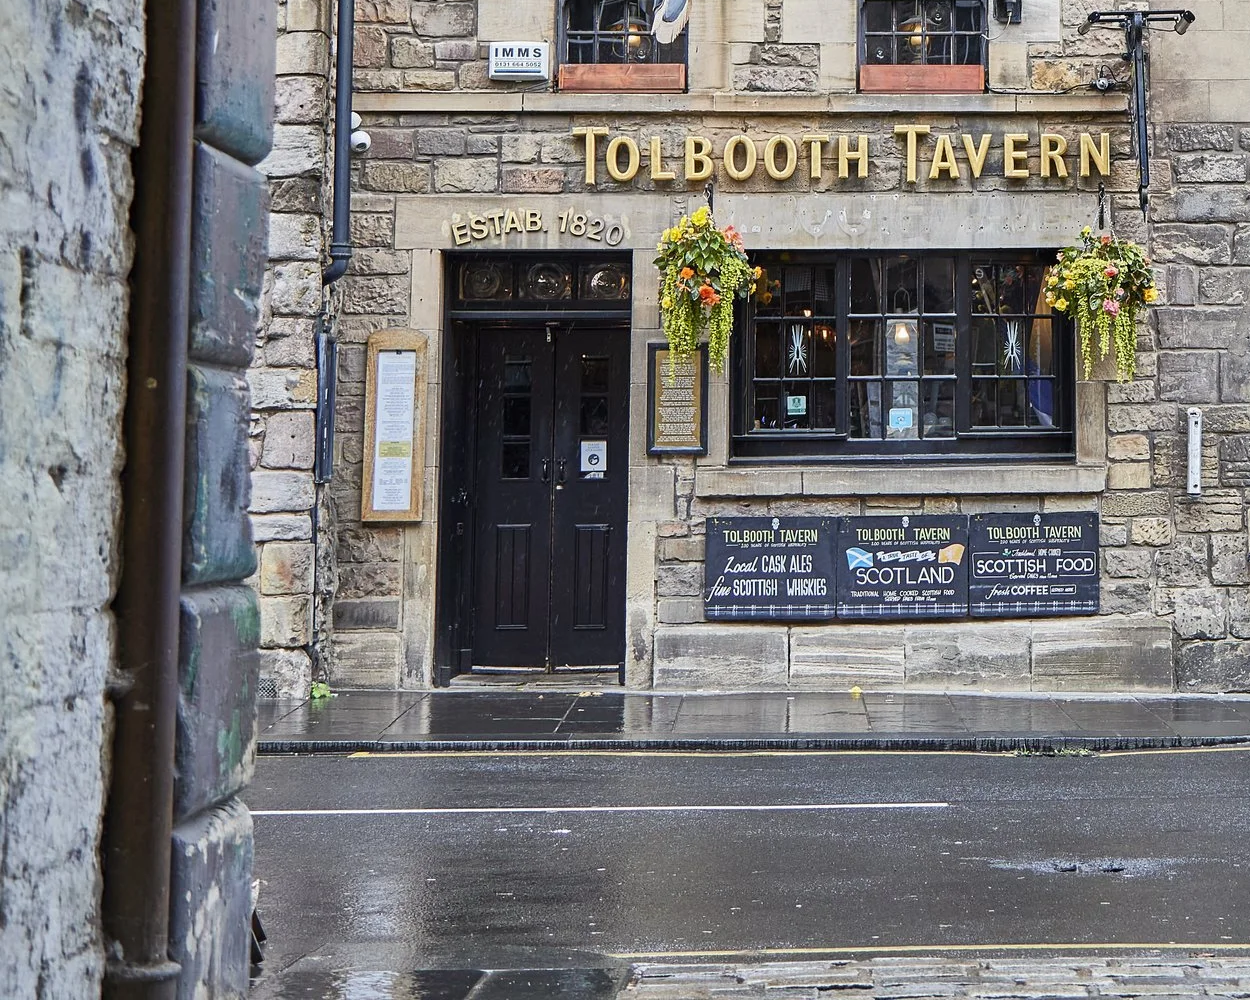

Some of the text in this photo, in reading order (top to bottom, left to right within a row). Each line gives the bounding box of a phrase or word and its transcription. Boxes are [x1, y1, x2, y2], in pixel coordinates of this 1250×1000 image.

[494, 47, 542, 58] IMMS
[451, 207, 624, 246] ESTAB. 1820
[723, 529, 818, 543] TOLBOOTH TAVERN
[856, 527, 950, 541] TOLBOOTH TAVERN
[987, 526, 1082, 539] TOLBOOTH TAVERN
[724, 555, 812, 574] Local CASK ALES
[976, 558, 1093, 574] SCOTTISH FOOD
[856, 566, 955, 585] SCOTLAND
[705, 575, 827, 603] fine SCOTTISH WHISKIES
[850, 590, 880, 598] TRADITIONAL
[985, 583, 1010, 600] fresh
[1011, 585, 1049, 596] COFFEE
